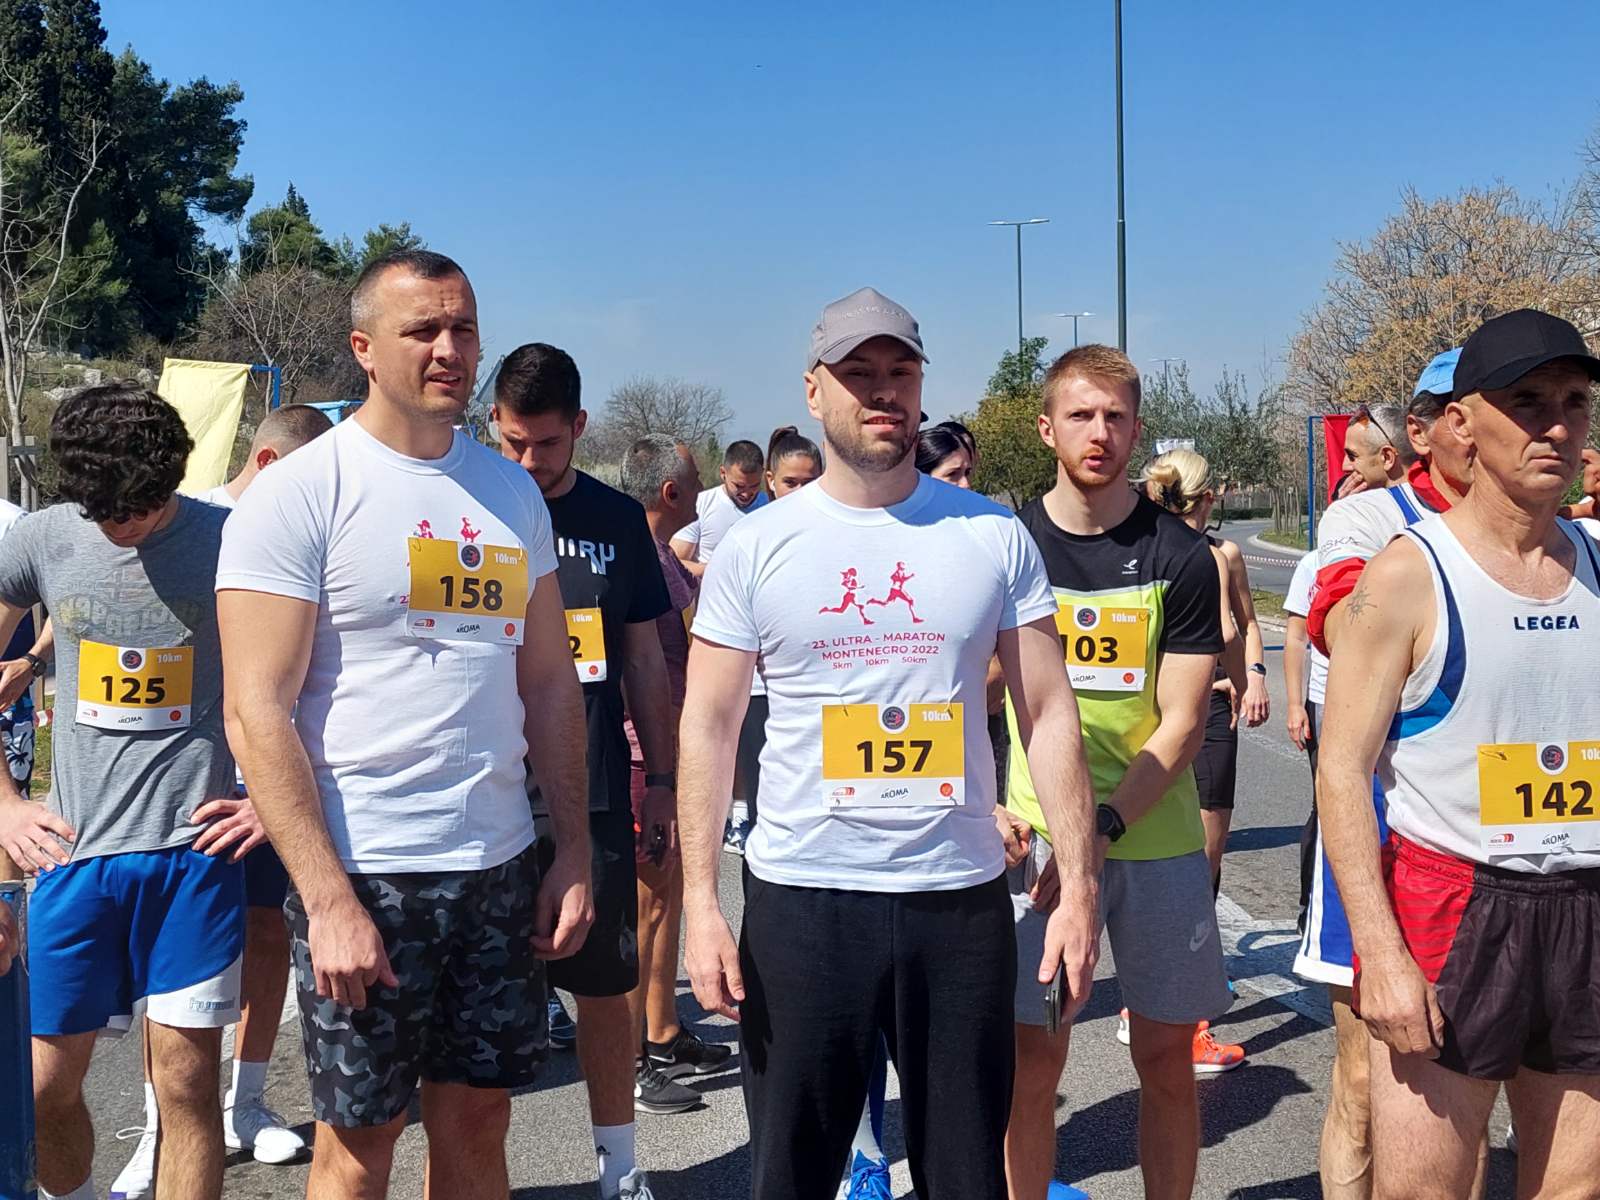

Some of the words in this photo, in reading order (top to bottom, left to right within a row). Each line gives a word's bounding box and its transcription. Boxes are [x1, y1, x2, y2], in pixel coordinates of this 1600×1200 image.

[494, 552, 518, 565] 10km
[440, 575, 503, 611] 158
[571, 613, 593, 623] 10km
[1111, 612, 1137, 623] 10km
[1513, 615, 1580, 631] LEGEA
[811, 640, 829, 650] 23.
[832, 635, 872, 647] ULTRA
[883, 632, 946, 642] MARATON
[157, 654, 183, 664] 10km
[822, 645, 909, 661] MONTENEGRO
[911, 645, 940, 655] 2022
[832, 661, 853, 670] 5km
[865, 658, 889, 667] 10km
[902, 656, 928, 665] 50km
[101, 675, 166, 704] 125
[922, 710, 952, 722] 10km
[856, 740, 933, 773] 157
[880, 787, 909, 799] AROMA
[1514, 780, 1594, 818] 142
[1541, 832, 1570, 846] AROMA
